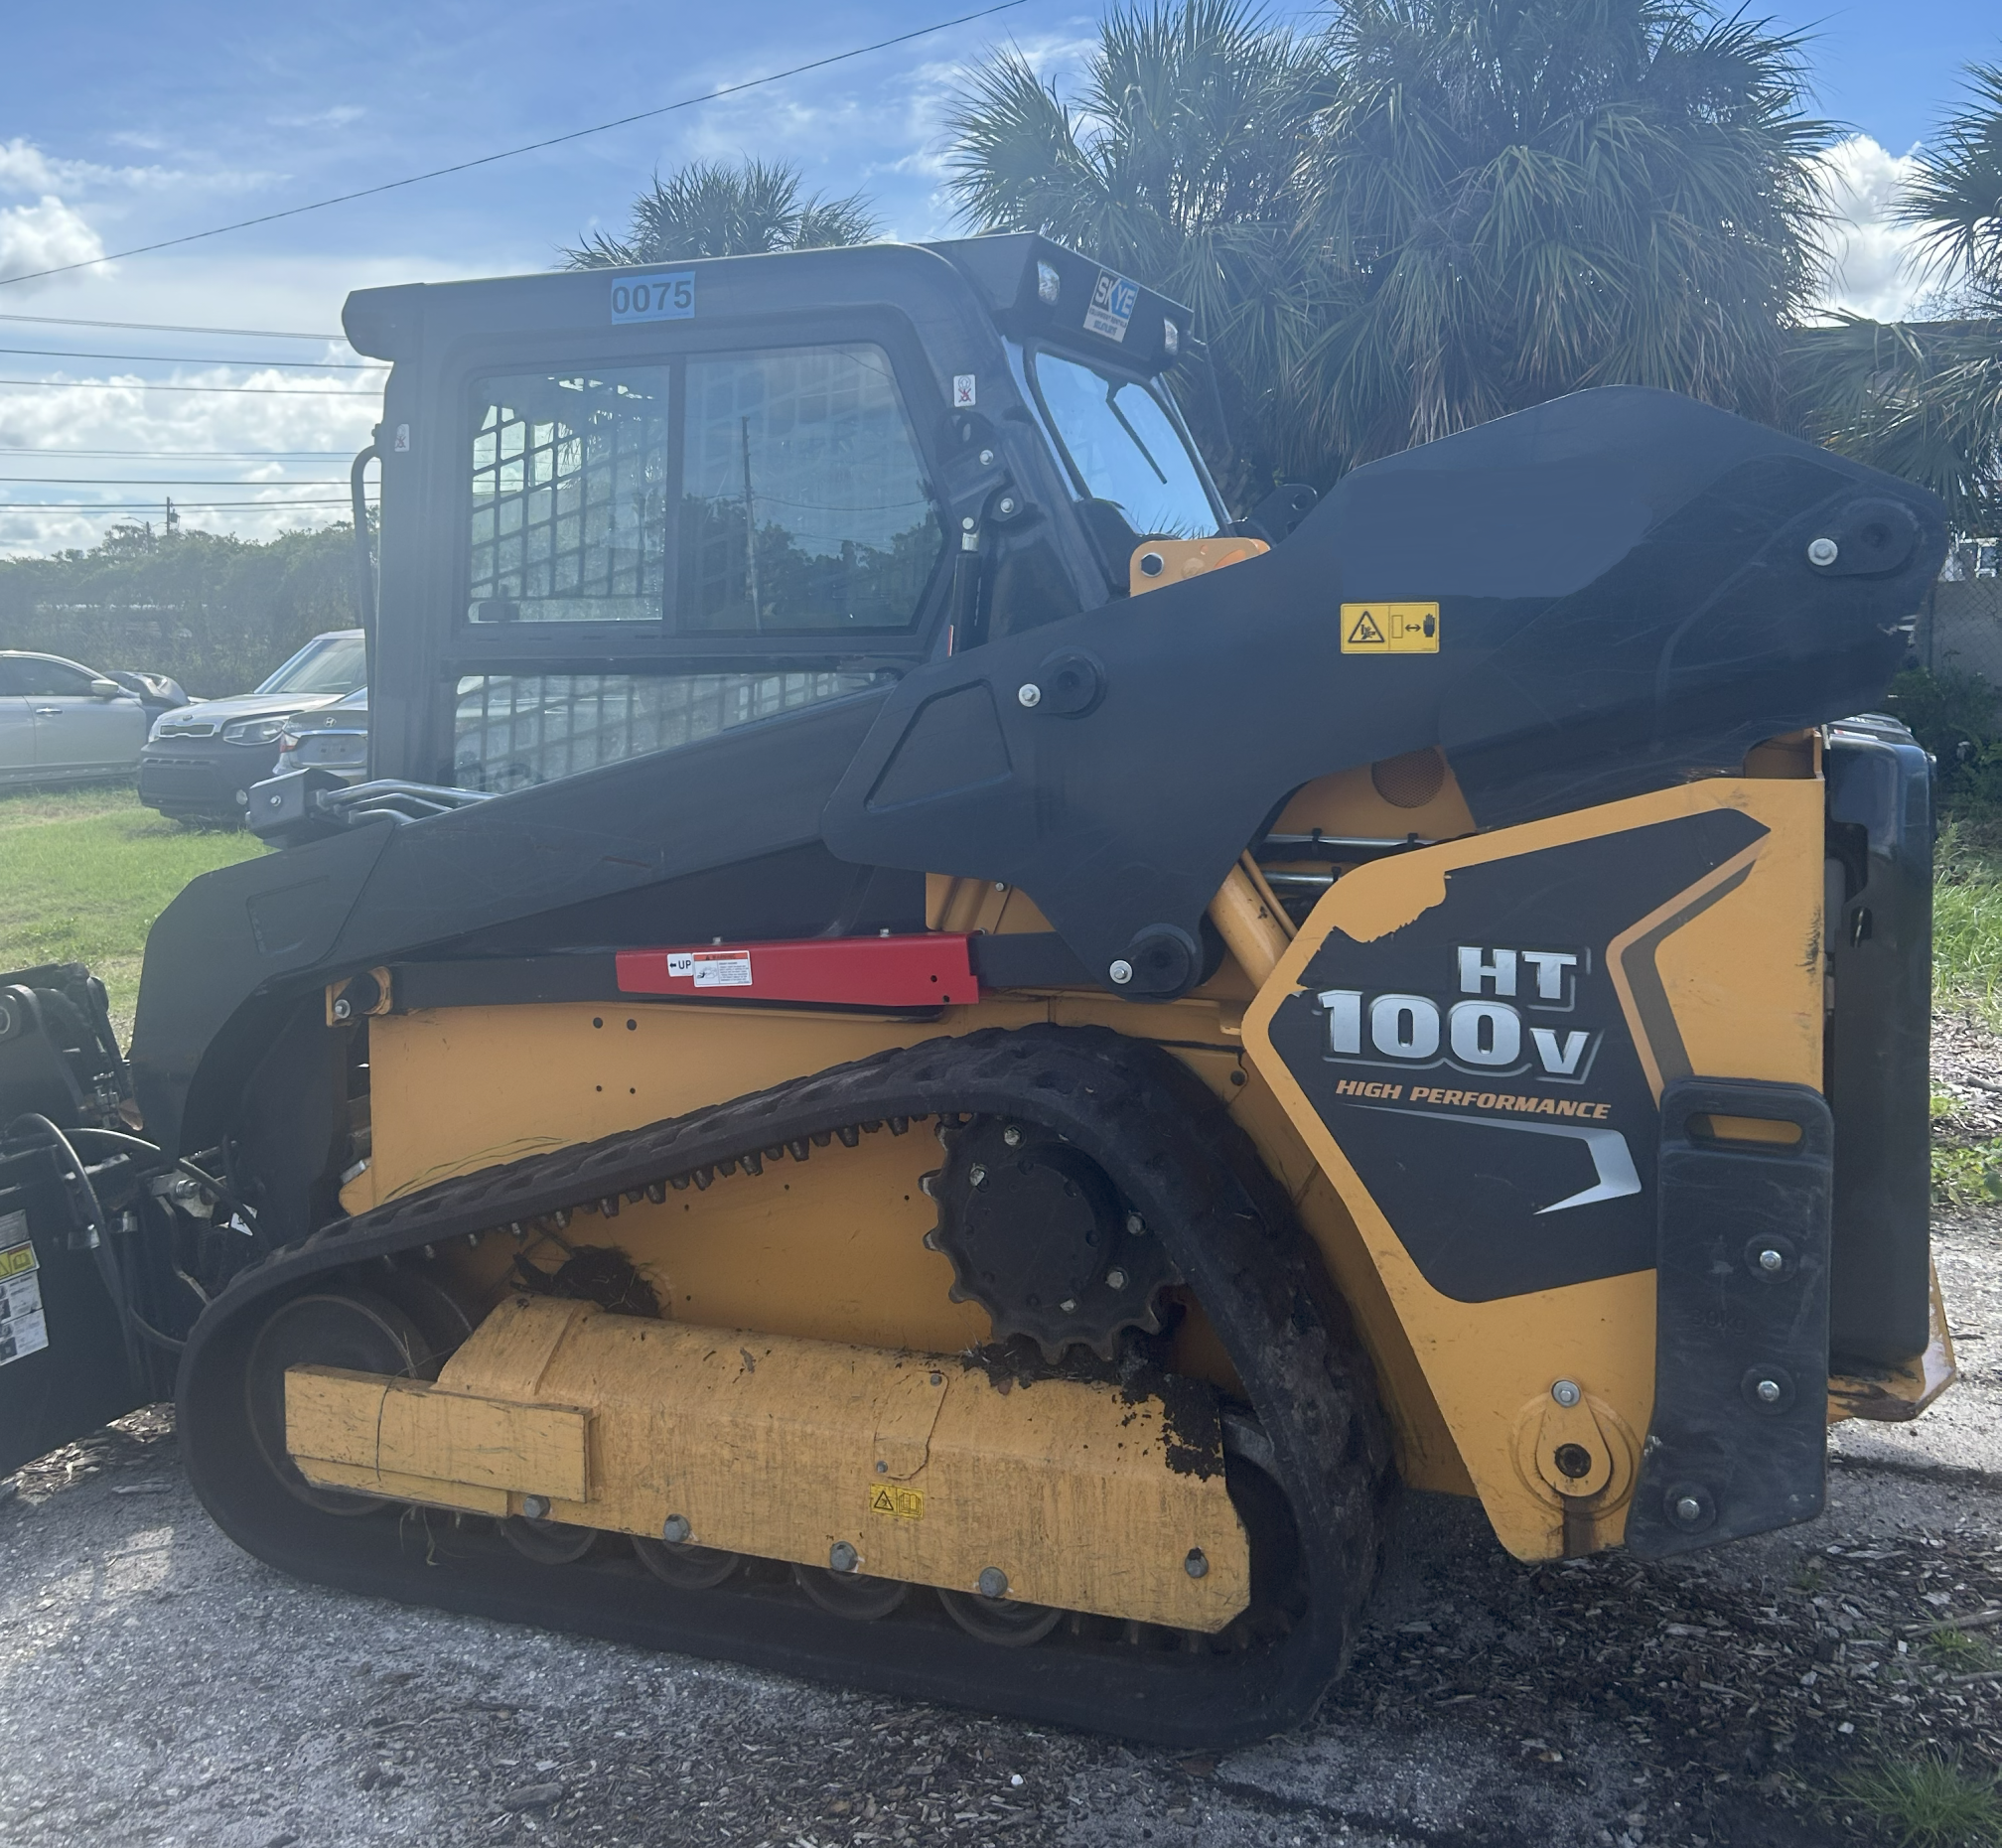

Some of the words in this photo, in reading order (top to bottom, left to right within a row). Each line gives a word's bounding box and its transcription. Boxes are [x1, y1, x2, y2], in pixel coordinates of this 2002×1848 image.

[613, 280, 692, 314] 0075
[1094, 276, 1136, 316] SKYE
[678, 959, 692, 970] UP
[1457, 945, 1578, 1000] HT
[1336, 1079, 1403, 1100] HIGH
[1409, 1086, 1612, 1120] PERFORMANCE
